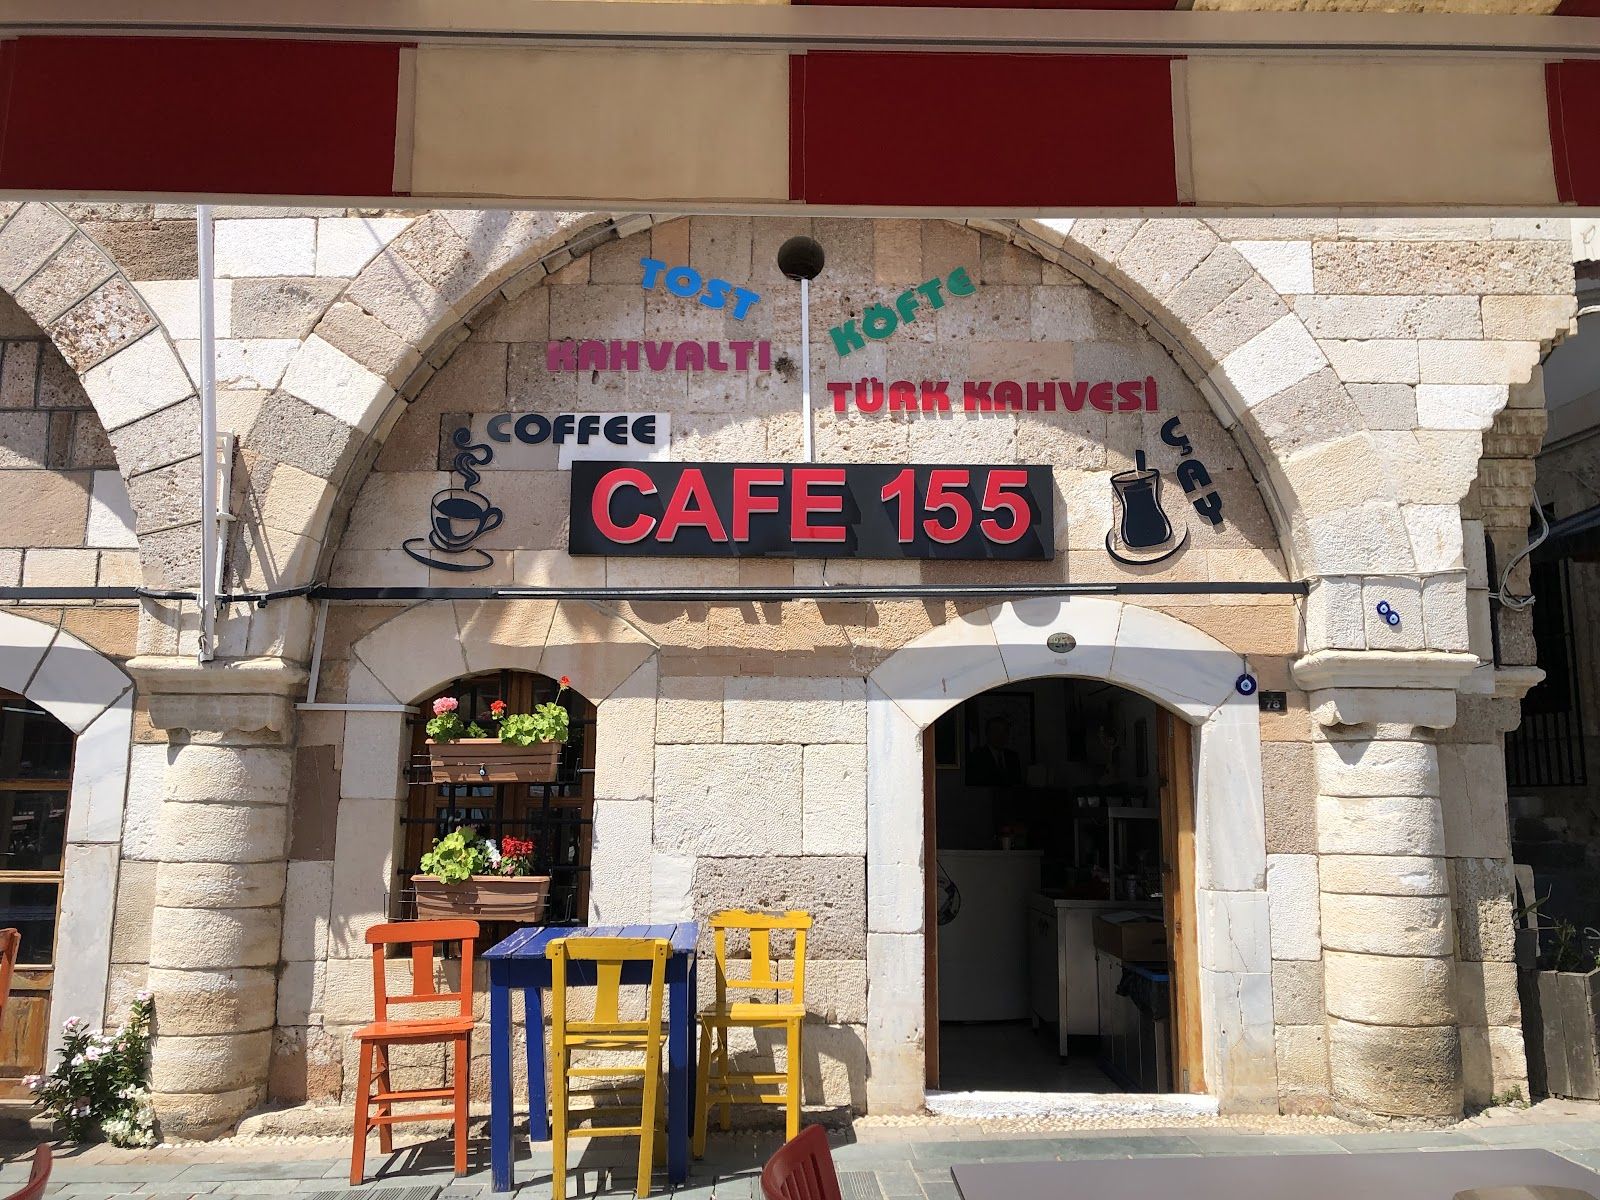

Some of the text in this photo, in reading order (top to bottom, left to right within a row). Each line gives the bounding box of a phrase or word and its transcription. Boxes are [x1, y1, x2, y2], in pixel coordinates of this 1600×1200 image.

[640, 257, 761, 321] TOST
[828, 266, 977, 357] KÖFTE
[547, 340, 771, 372] KAHVALTI
[827, 375, 1158, 413] TÜRK KAHVESİ
[487, 413, 656, 445] COFFEE
[1160, 416, 1225, 527] ÇAY
[592, 468, 1031, 544] CAFE 155
[1265, 700, 1280, 709] 78
